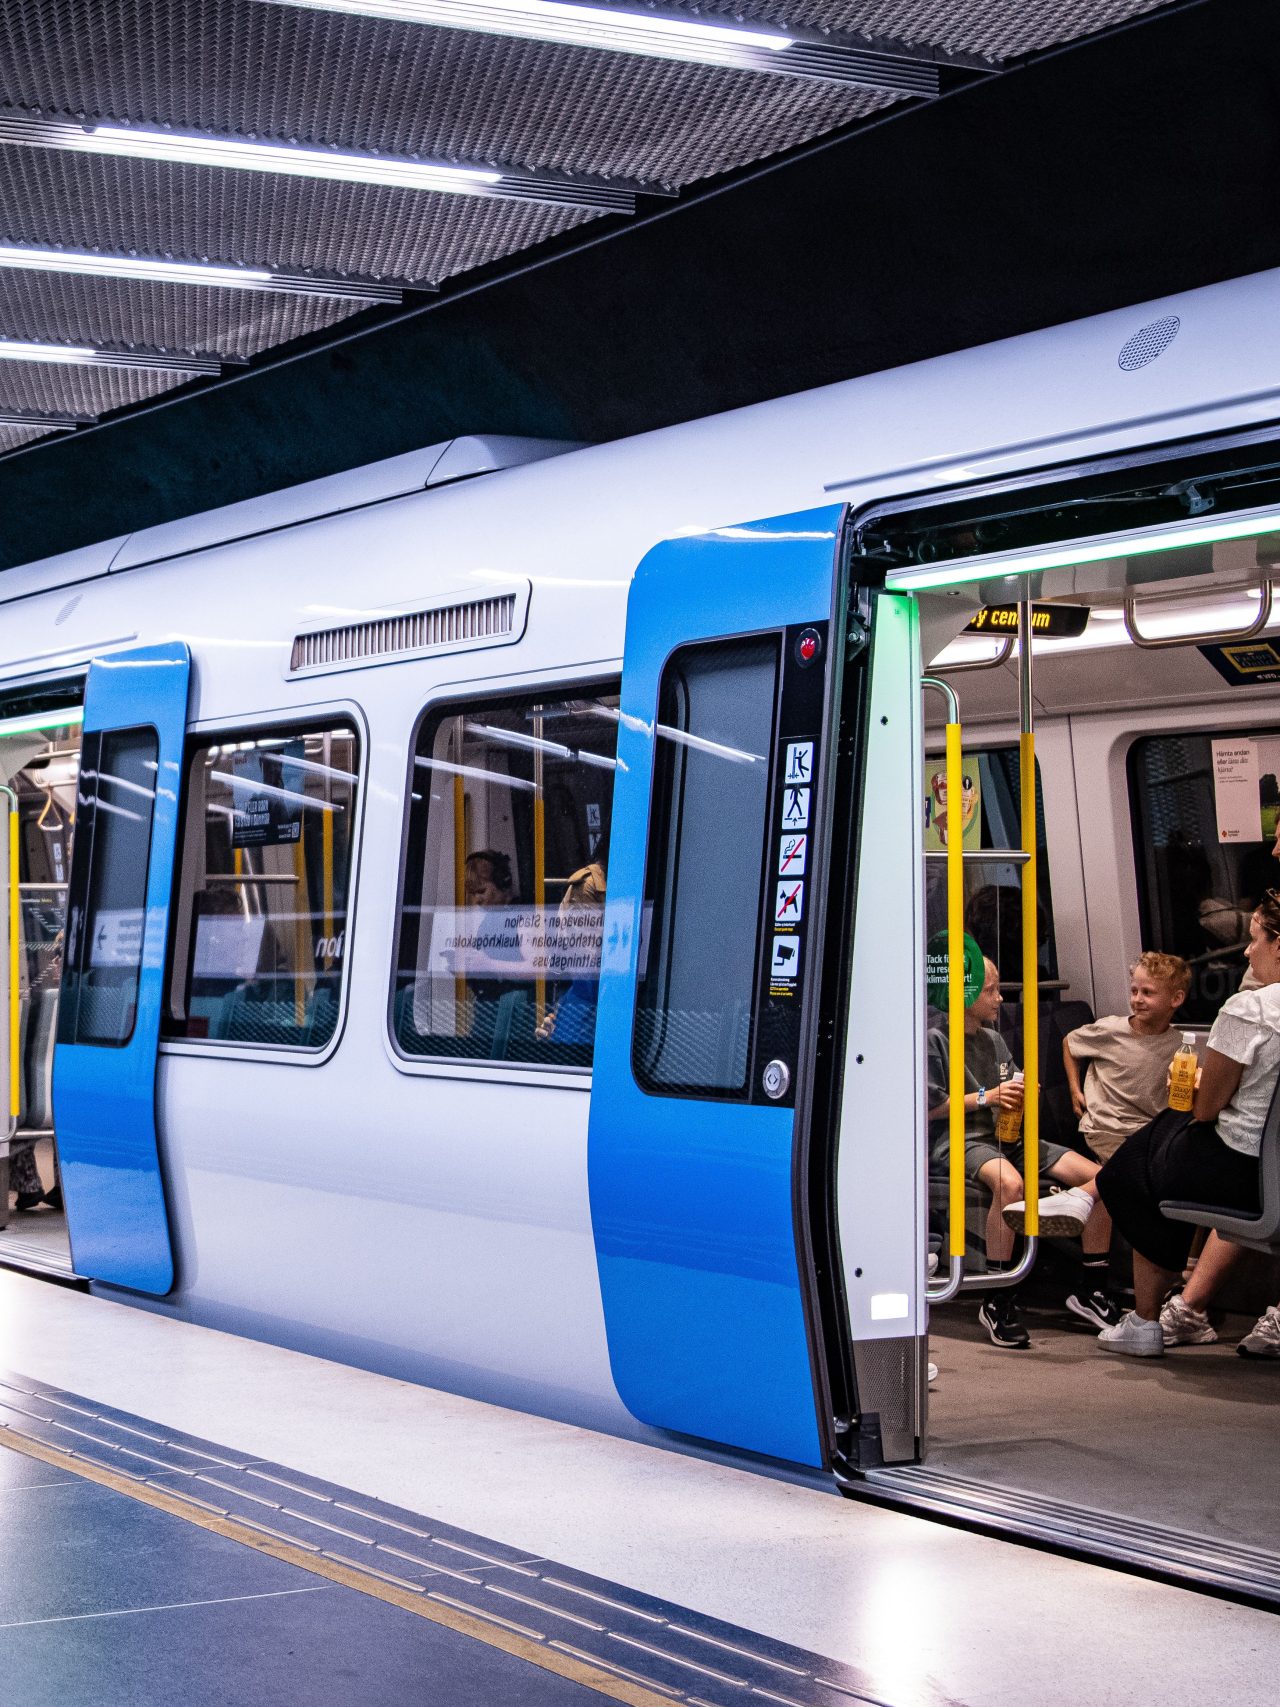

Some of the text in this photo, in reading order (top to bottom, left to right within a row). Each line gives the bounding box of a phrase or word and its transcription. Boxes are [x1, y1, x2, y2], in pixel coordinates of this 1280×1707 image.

[991, 610, 1051, 627] cenum
[926, 954, 942, 964] Tack
[926, 965, 935, 973] du
[926, 974, 972, 983] klimatrt!
